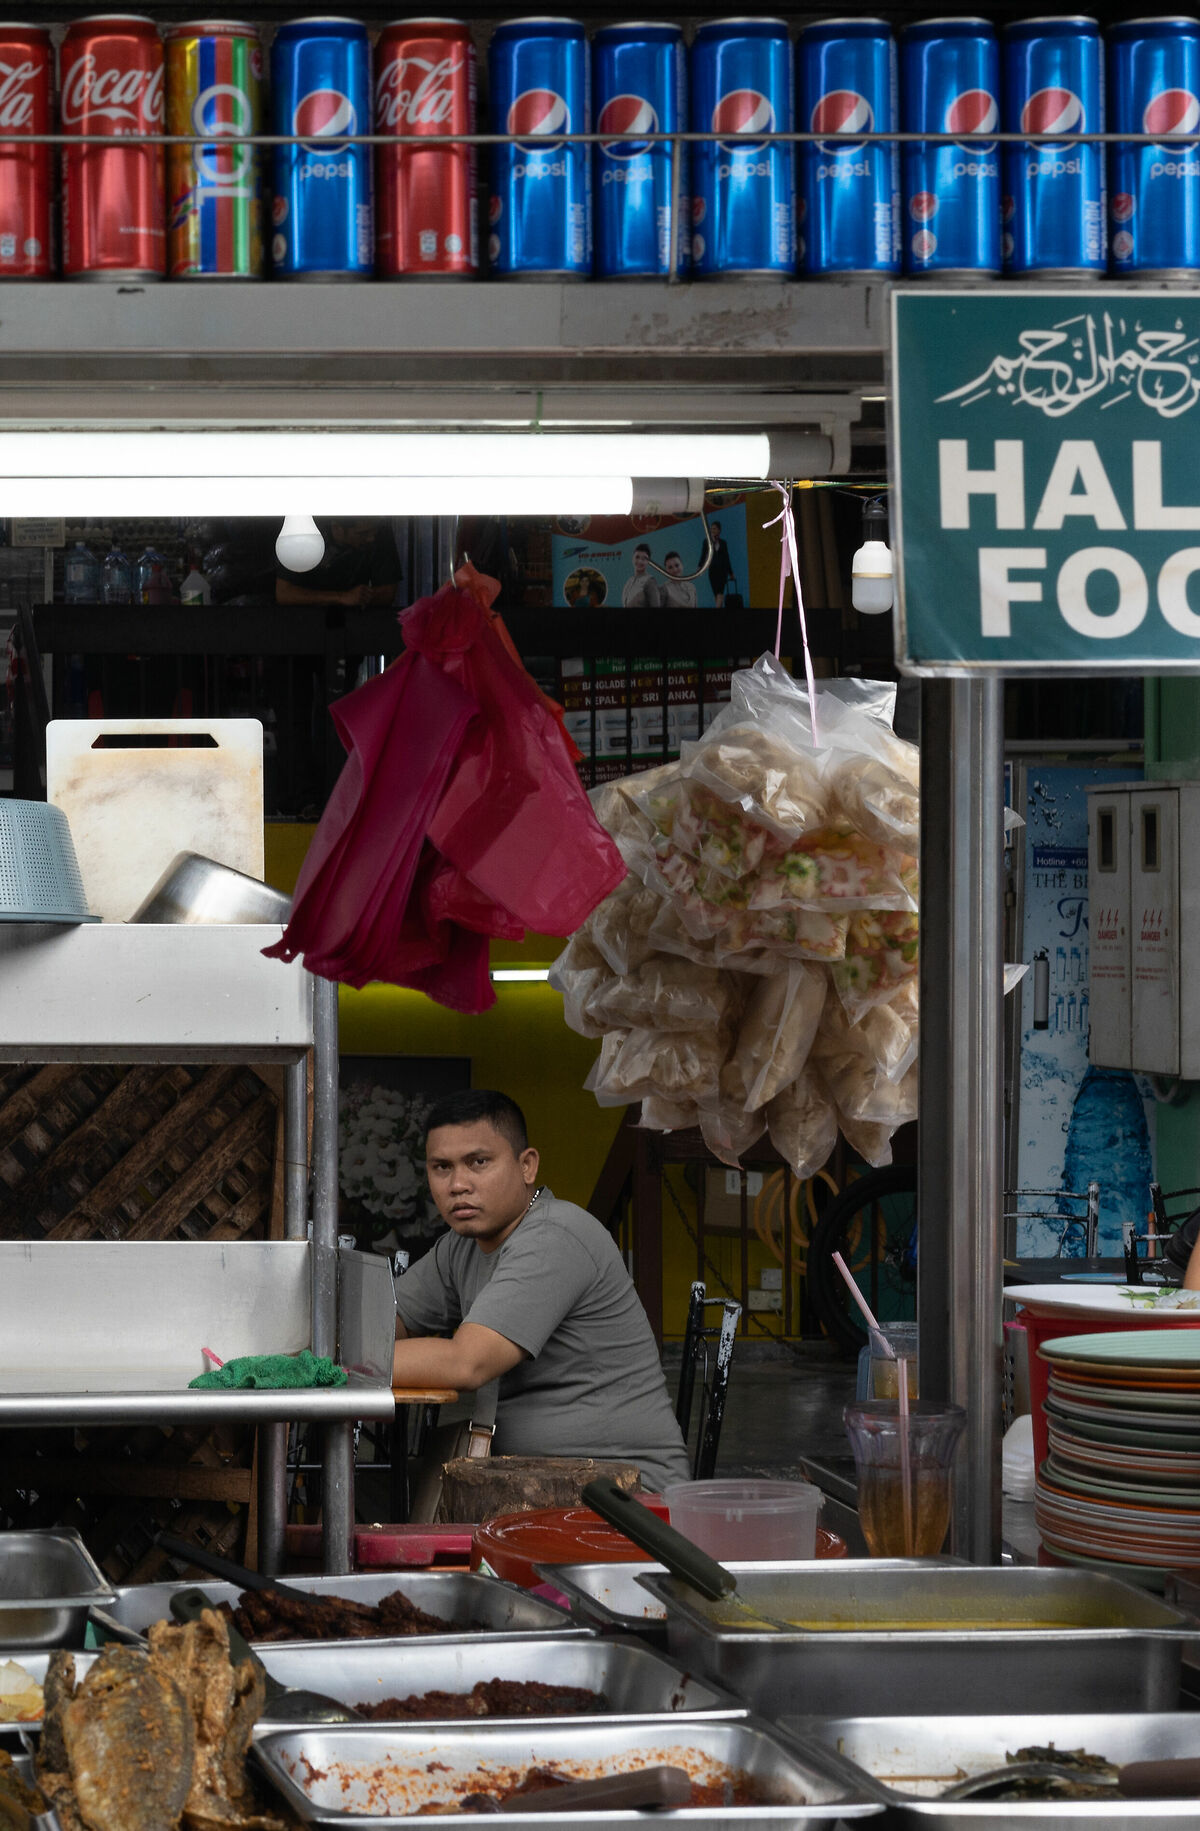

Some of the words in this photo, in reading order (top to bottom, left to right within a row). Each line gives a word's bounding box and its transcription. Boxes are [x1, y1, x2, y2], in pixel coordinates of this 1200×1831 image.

[300, 160, 354, 181] pepsi
[513, 159, 568, 180] pepsi
[602, 164, 655, 185] pepsi
[718, 159, 772, 181] pepsi
[816, 160, 871, 181] pepsi
[1026, 158, 1083, 179] pepsi
[582, 677, 637, 690] BANGLADEH
[642, 690, 659, 702] SRI
[668, 688, 697, 701] ANKA
[1036, 856, 1067, 866] Hotline
[1033, 872, 1066, 889] THE
